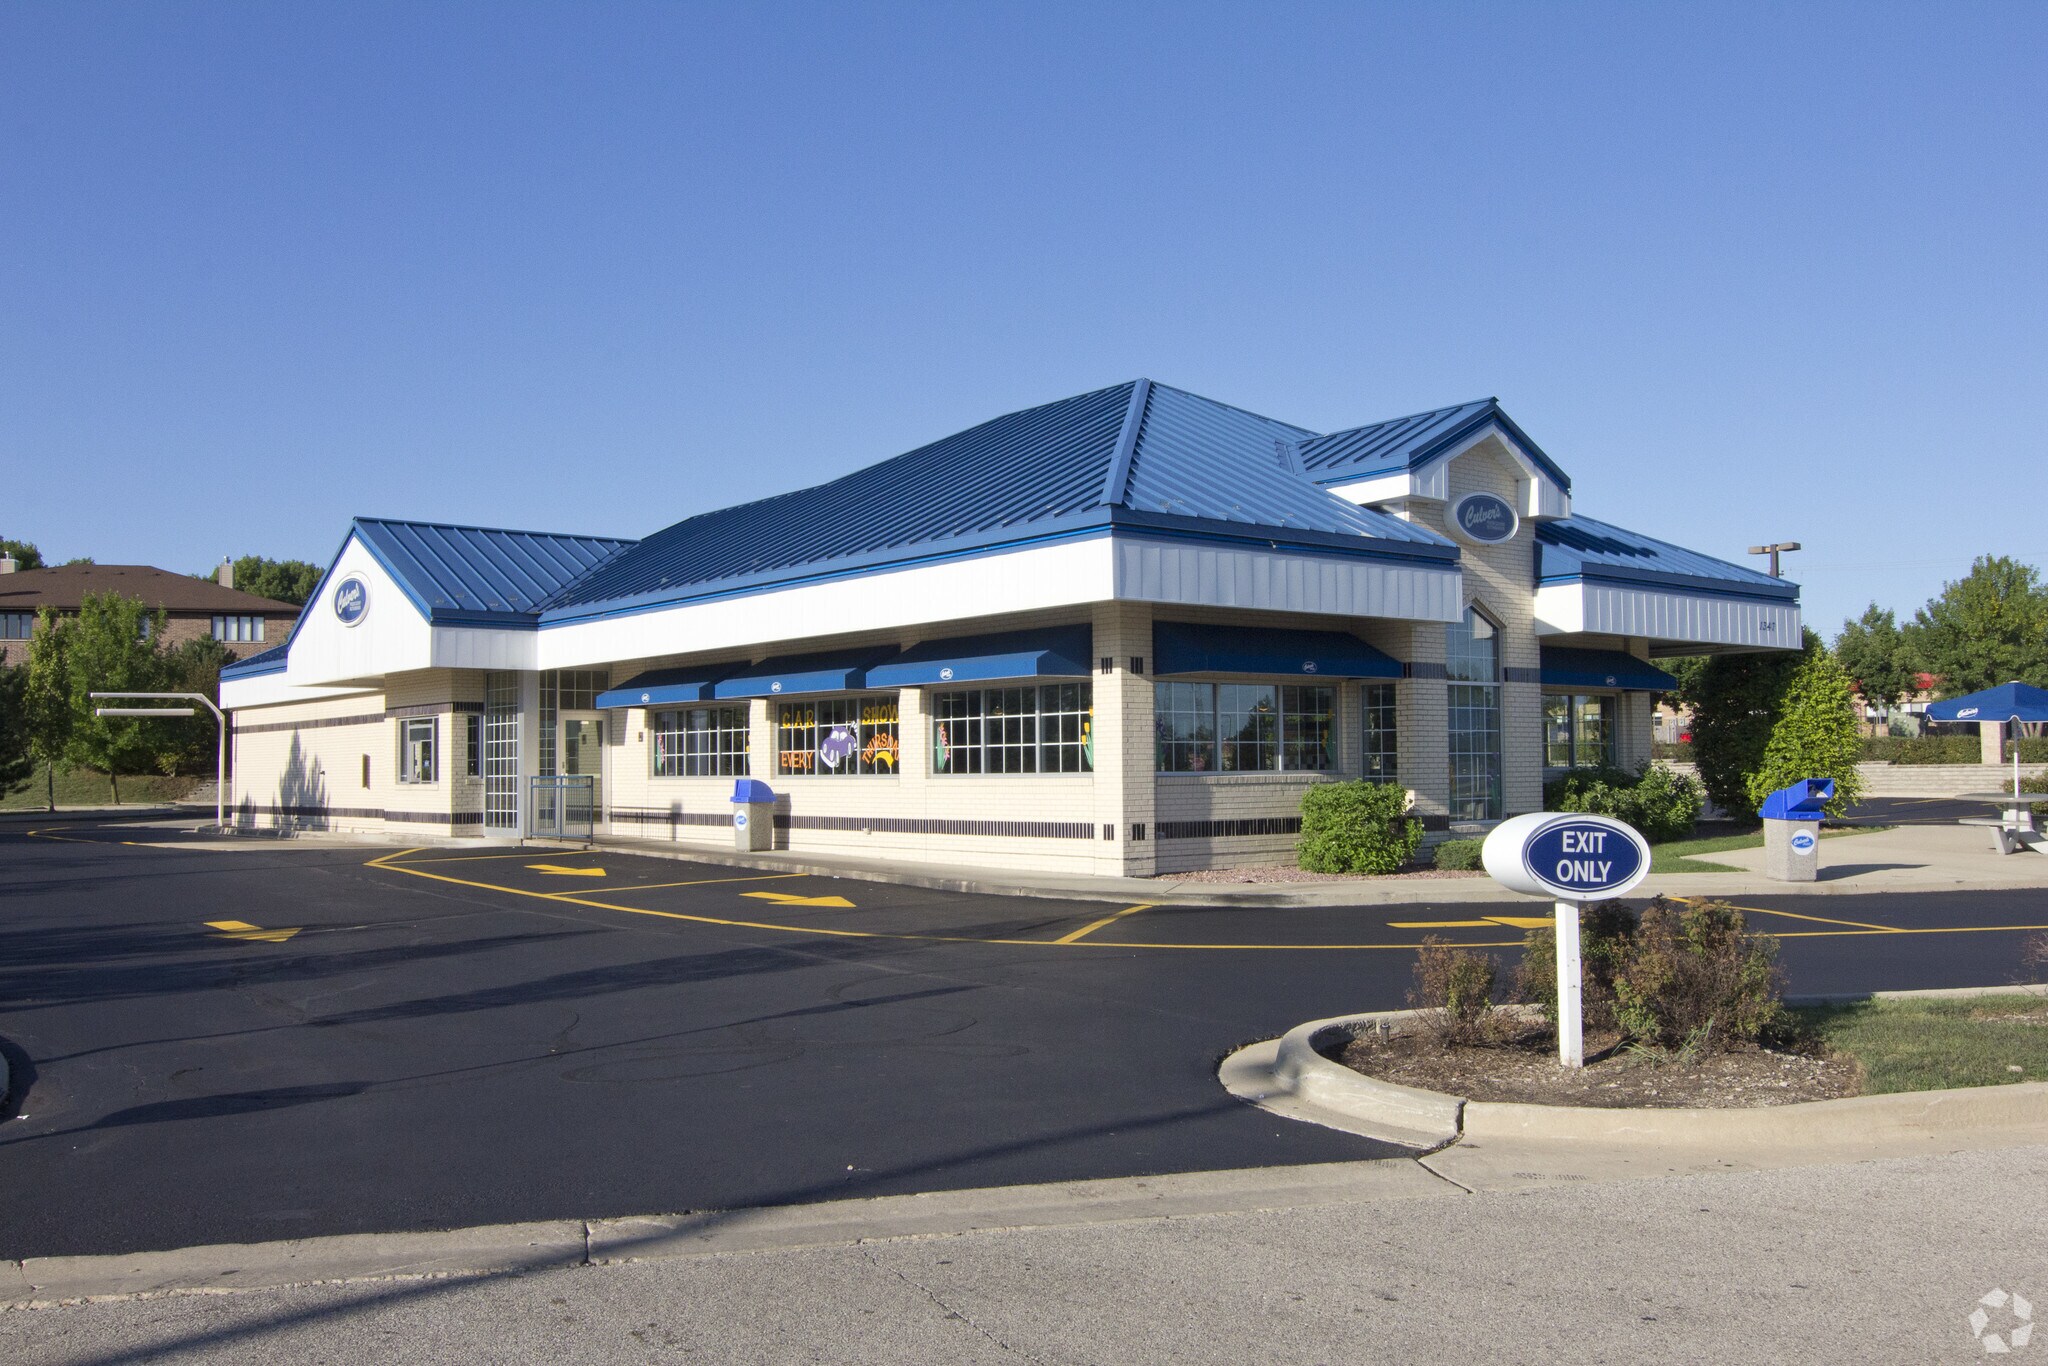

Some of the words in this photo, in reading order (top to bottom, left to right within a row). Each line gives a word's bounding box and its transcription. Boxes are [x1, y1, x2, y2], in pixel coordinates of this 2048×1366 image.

[1465, 503, 1502, 528] Culver's
[782, 709, 815, 730] CAR
[861, 704, 899, 725] SHOW
[781, 751, 813, 769] EVERY
[1562, 830, 1607, 853] EXIT
[1556, 859, 1612, 882] ONLY
